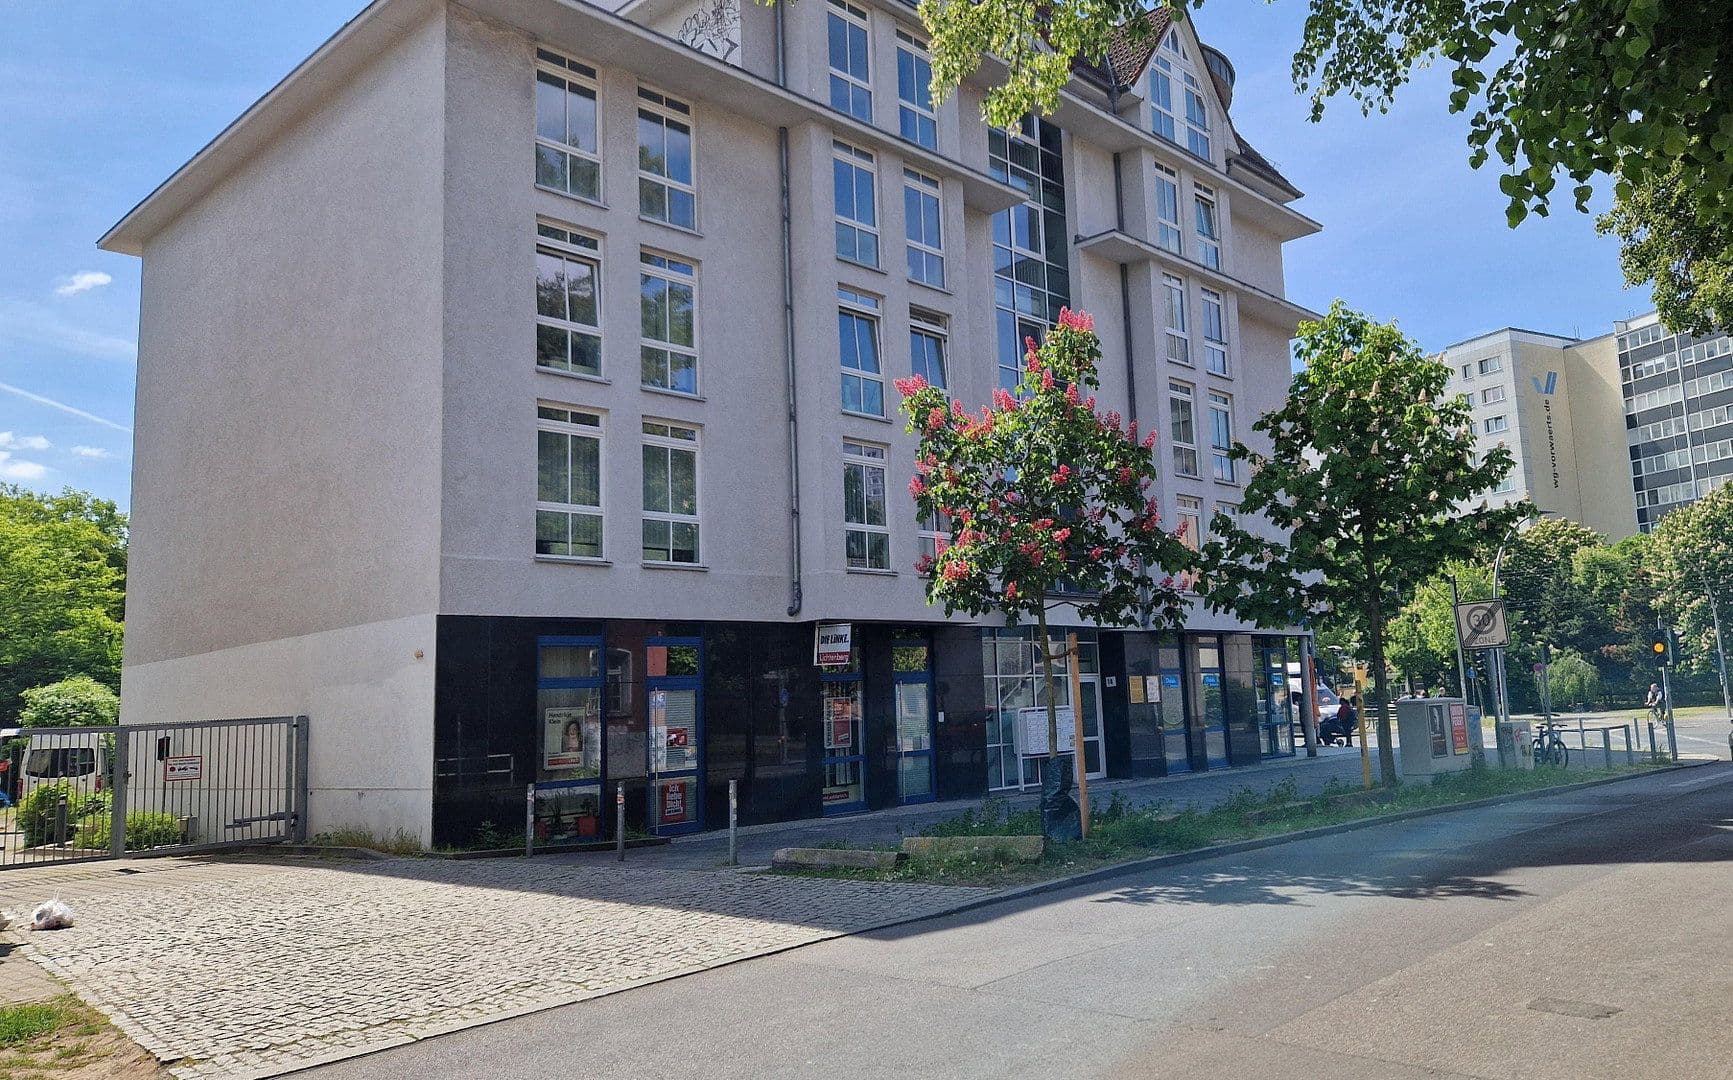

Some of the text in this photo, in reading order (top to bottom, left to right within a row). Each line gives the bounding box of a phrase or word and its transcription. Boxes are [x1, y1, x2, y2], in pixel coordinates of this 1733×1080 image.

[1544, 399, 1559, 489] wg-vorwaerts.de
[1472, 613, 1490, 627] 30
[820, 652, 849, 664] Lichtenberg
